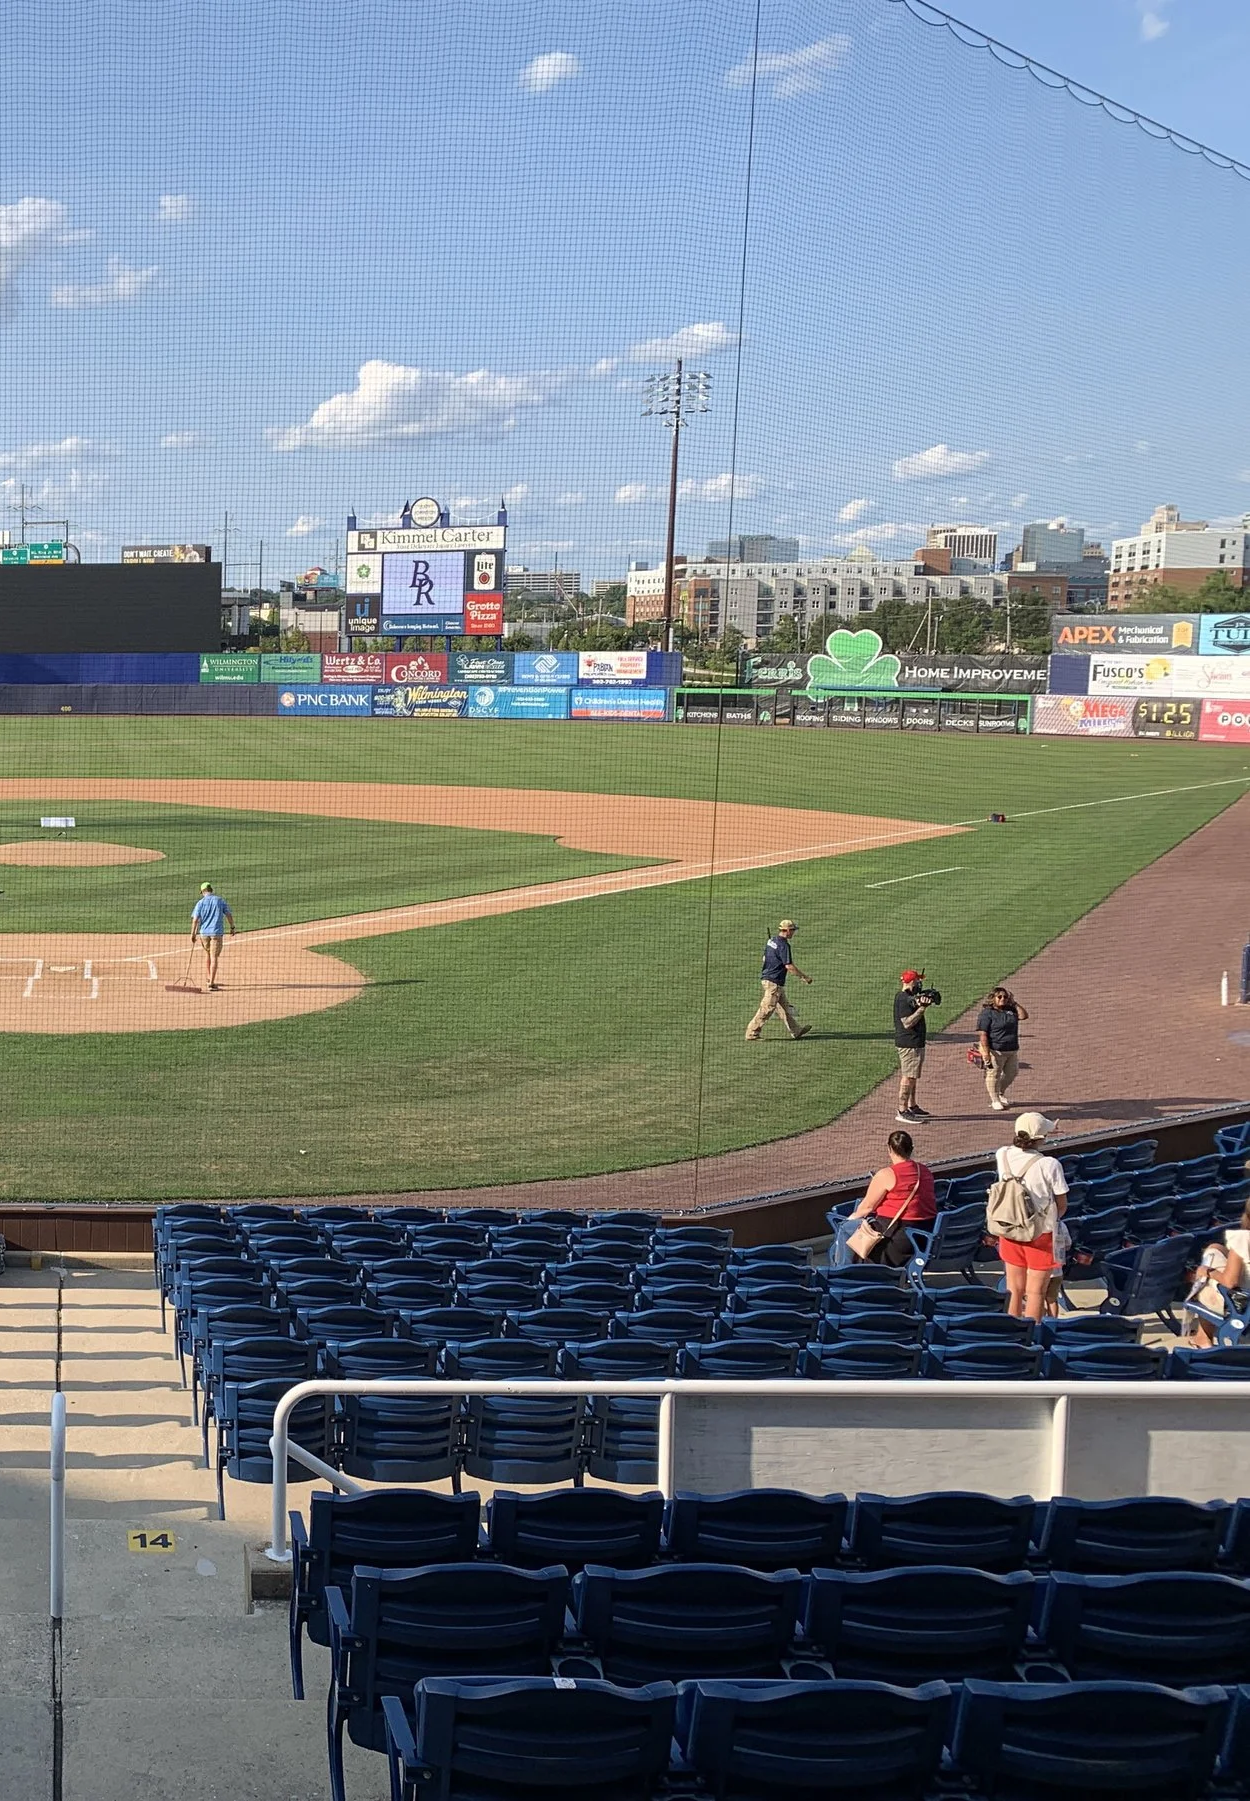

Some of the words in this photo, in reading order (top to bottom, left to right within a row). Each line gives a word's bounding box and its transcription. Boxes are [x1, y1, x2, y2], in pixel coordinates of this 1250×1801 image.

[382, 530, 438, 544] Kimmel
[442, 528, 494, 542] Carter
[477, 561, 494, 572] Lite
[466, 600, 500, 611] Grotto
[470, 611, 497, 620] Pizza
[348, 618, 378, 626] unique
[351, 624, 376, 632] image
[1057, 626, 1117, 644] APEX
[1118, 626, 1164, 634] Mechanical
[1118, 636, 1124, 644] &
[1125, 636, 1169, 644] Fabrication
[324, 655, 356, 666] Wertz
[357, 656, 366, 666] &
[390, 665, 442, 683] CONCORD
[905, 666, 950, 679] HOME
[1092, 664, 1145, 682] FUSCO'S
[298, 694, 328, 706] PNC
[329, 694, 369, 706] BANK
[406, 686, 468, 702] Wilmington
[640, 697, 664, 706] Health
[1082, 700, 1126, 718] MEGA
[1138, 702, 1191, 724] $1.25
[132, 1533, 173, 1549] 14
